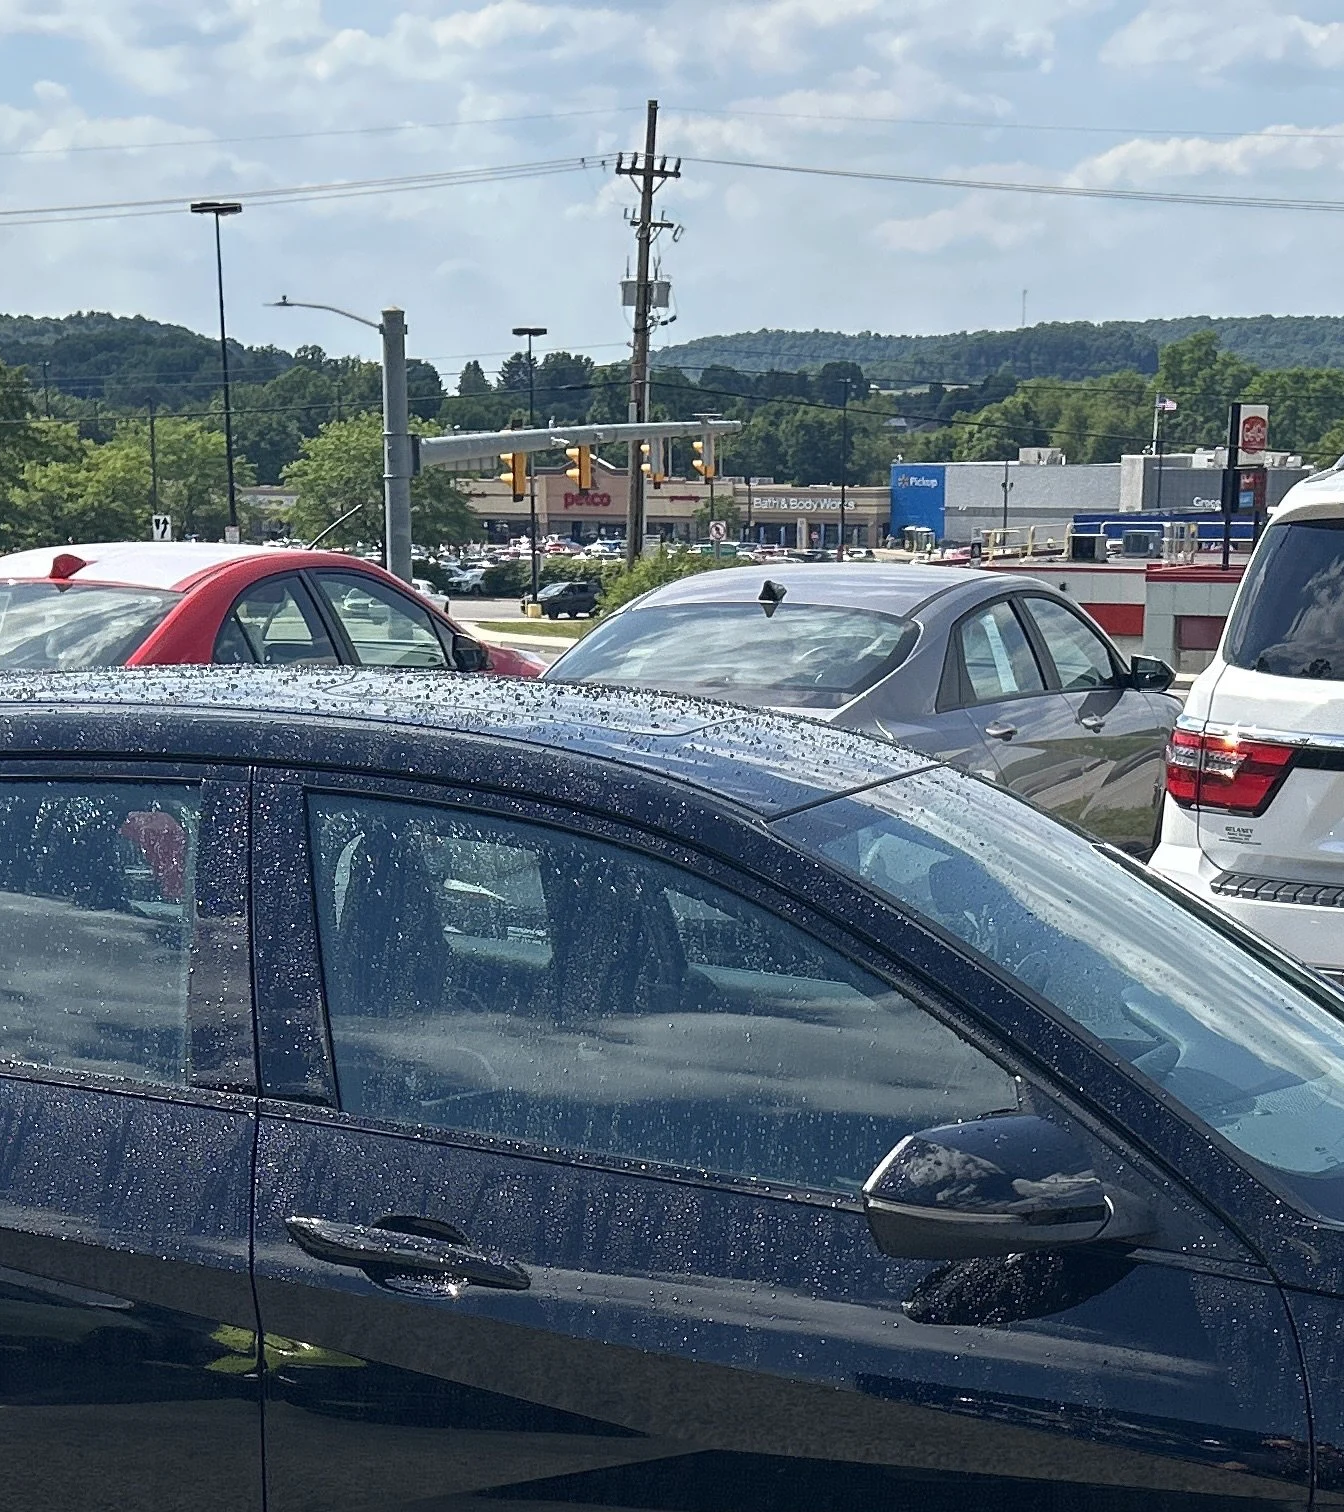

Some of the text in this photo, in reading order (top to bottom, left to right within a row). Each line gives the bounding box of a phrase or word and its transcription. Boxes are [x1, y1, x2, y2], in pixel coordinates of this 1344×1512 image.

[909, 476, 939, 489] Pickup
[563, 492, 611, 510] petco
[753, 497, 779, 509] Bath
[780, 499, 788, 509] &
[789, 498, 819, 512] Body
